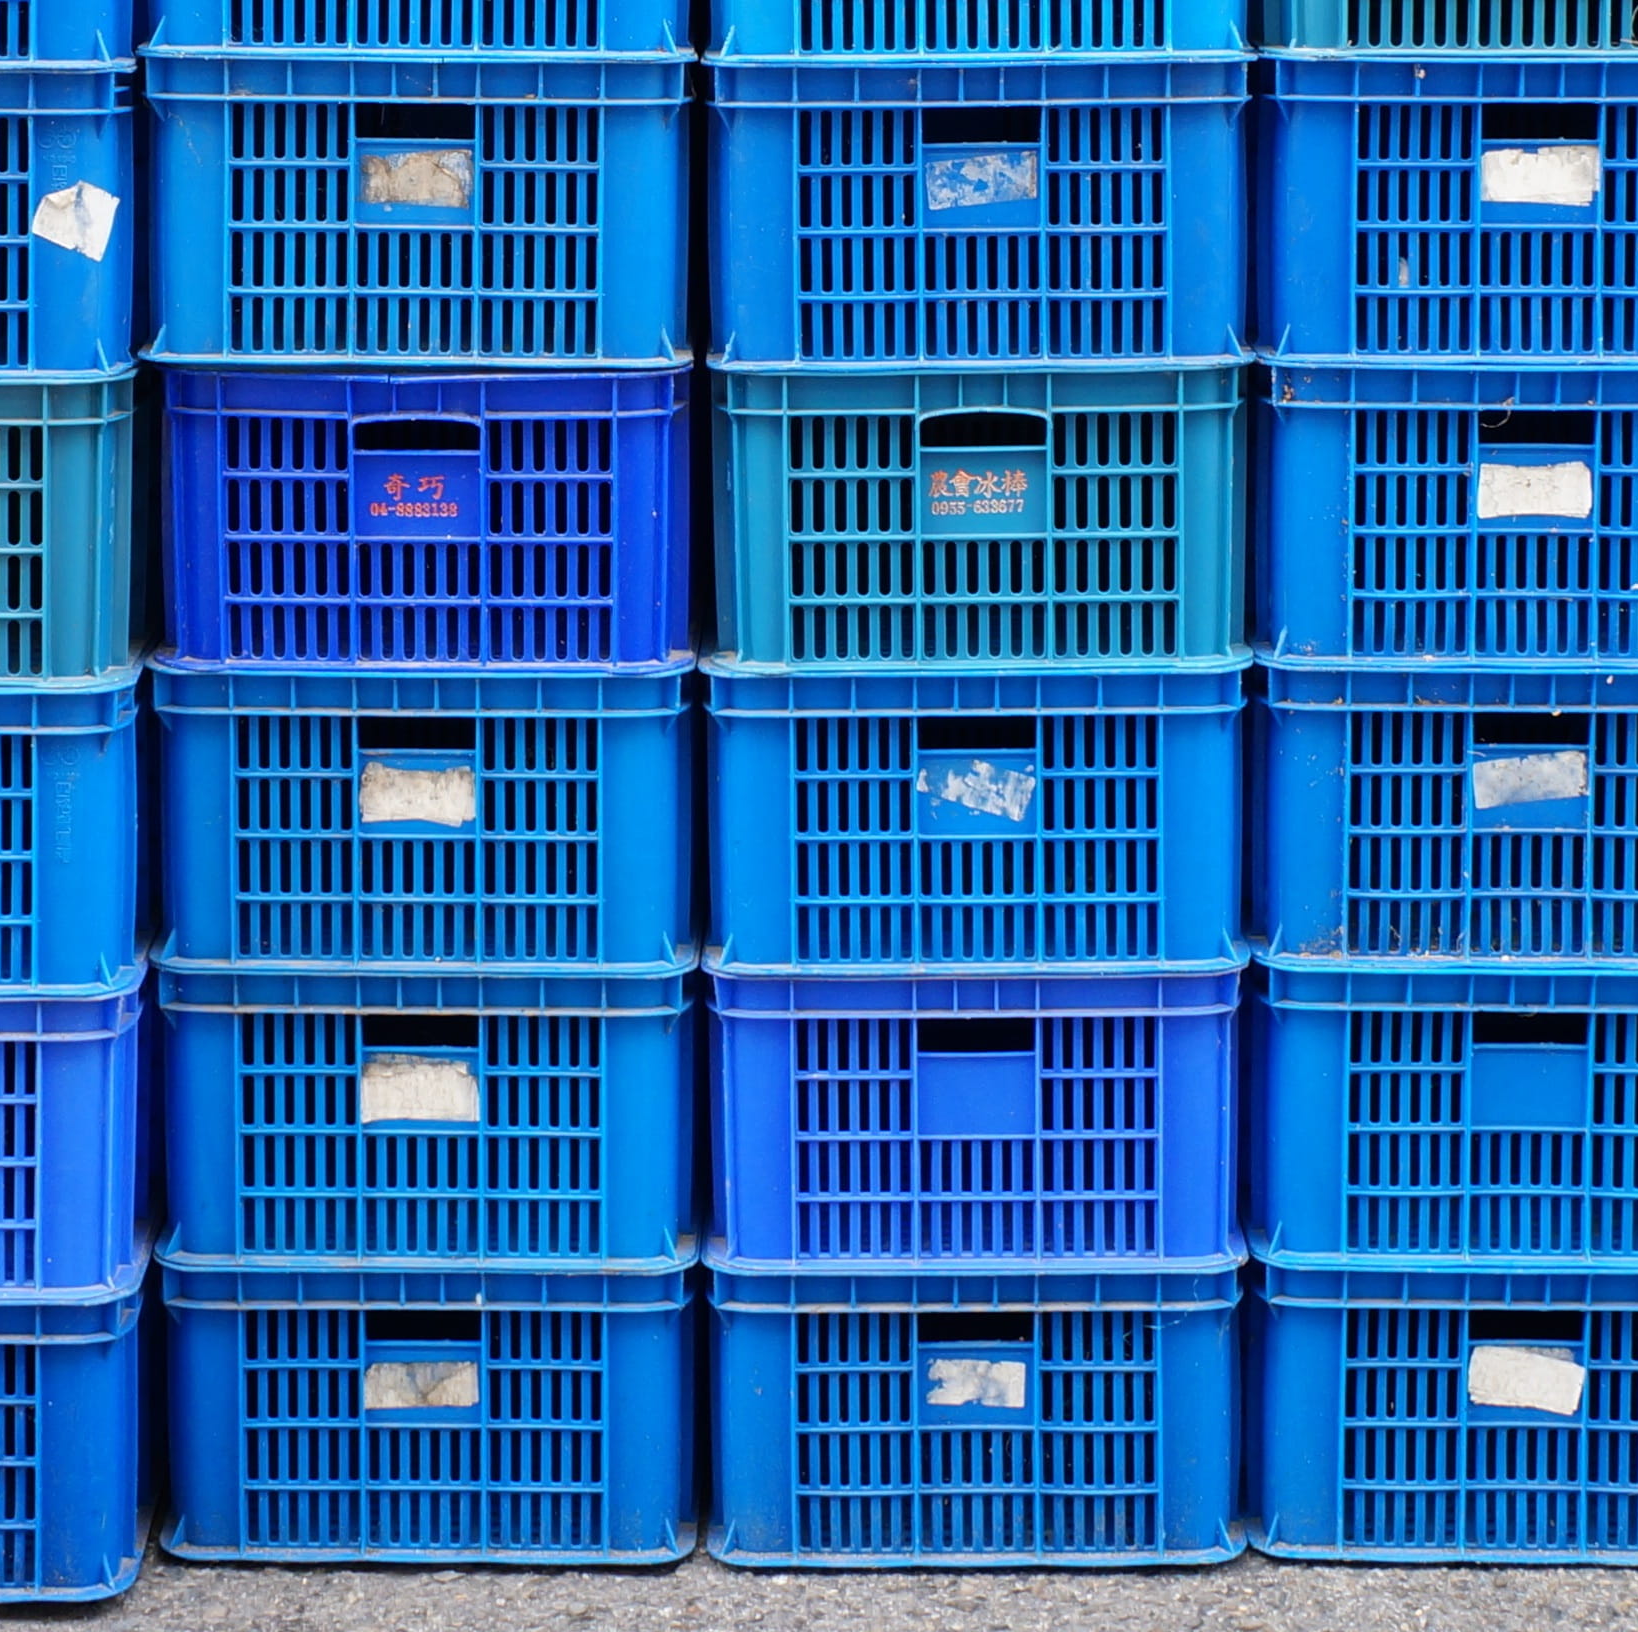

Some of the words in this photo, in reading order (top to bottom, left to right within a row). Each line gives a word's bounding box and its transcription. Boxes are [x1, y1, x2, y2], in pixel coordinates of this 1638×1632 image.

[383, 473, 446, 501] 奇巧
[929, 469, 1028, 497] 農會冰棒
